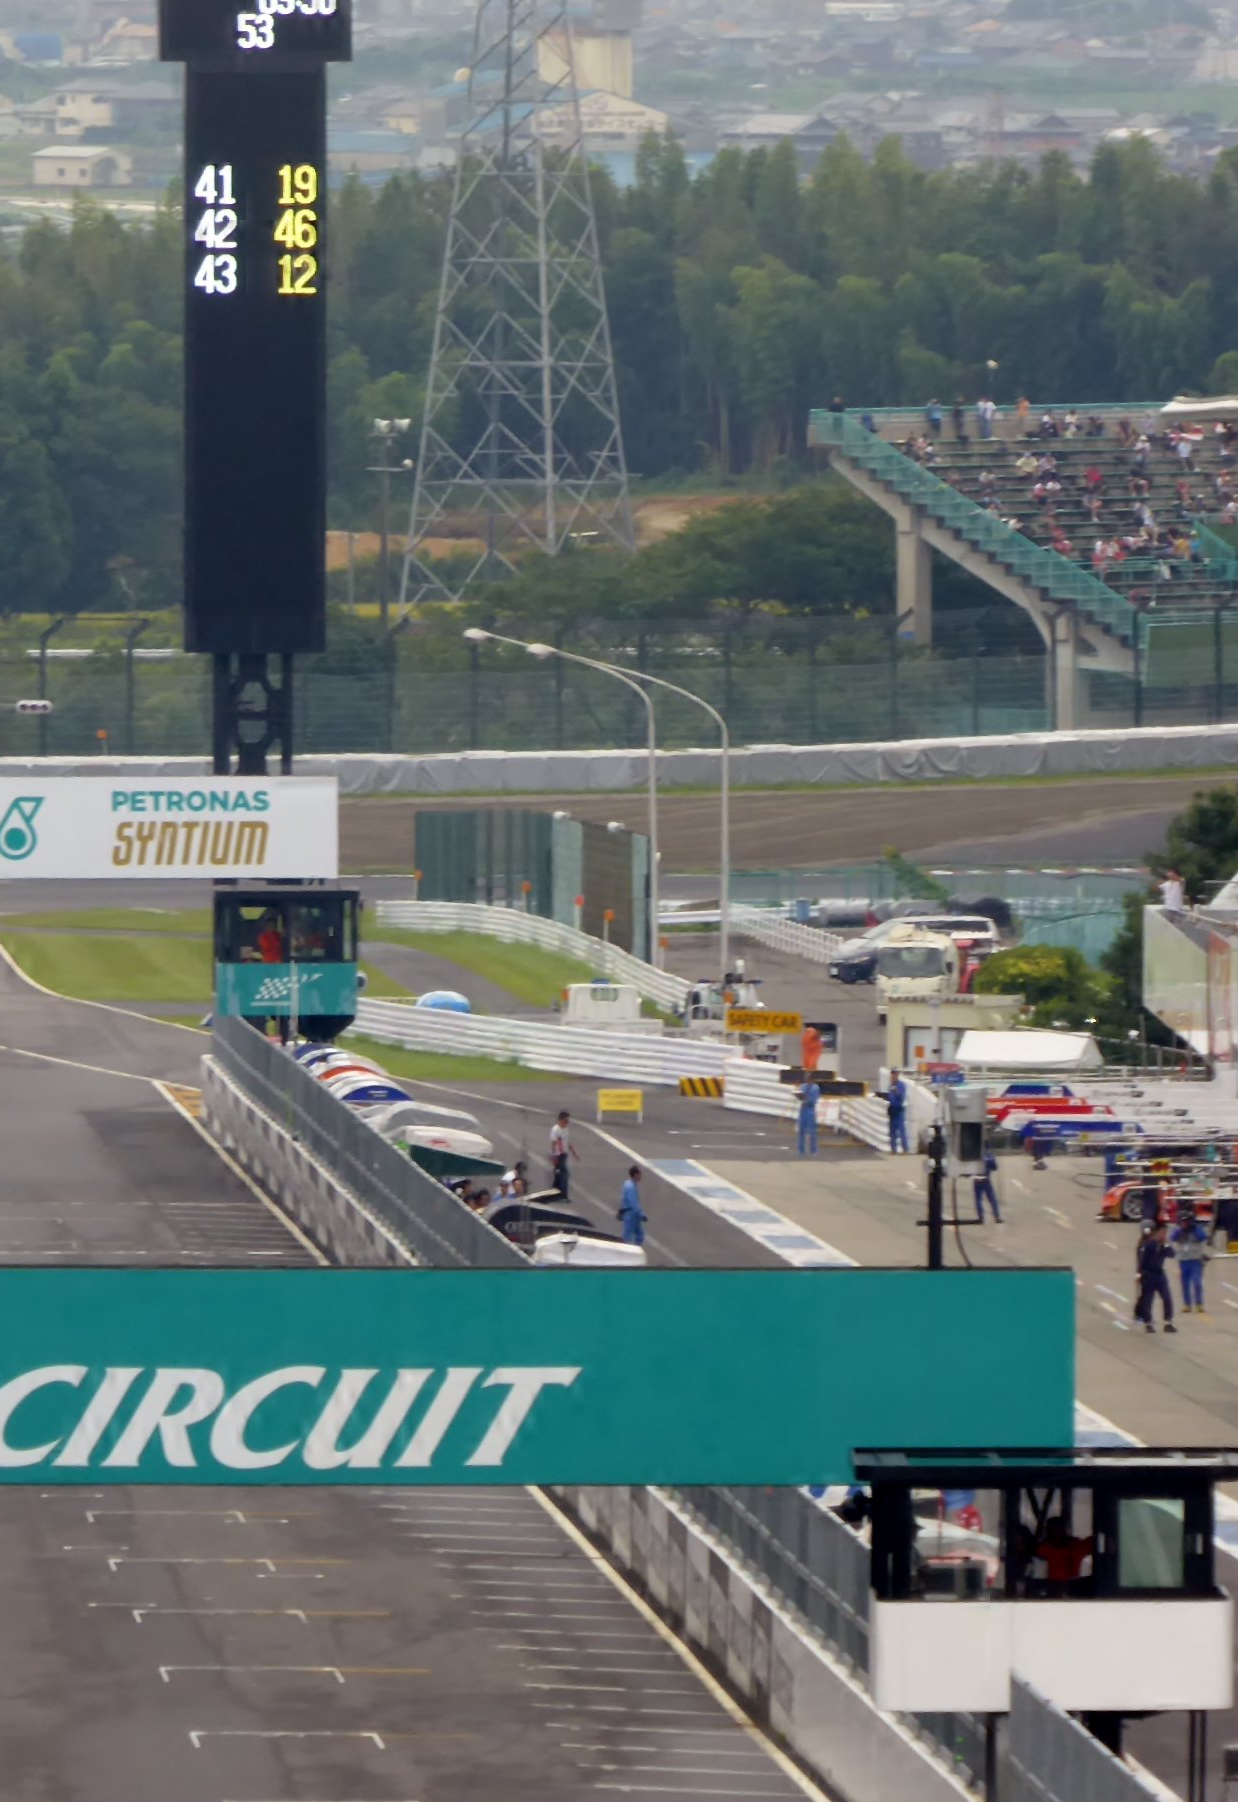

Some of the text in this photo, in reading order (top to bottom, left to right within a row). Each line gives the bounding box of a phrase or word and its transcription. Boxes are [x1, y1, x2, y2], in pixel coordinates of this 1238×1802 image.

[237, 13, 274, 49] 53
[194, 164, 317, 205] 41 19
[194, 208, 317, 249] 42 46
[194, 253, 317, 294] 43 12
[111, 790, 270, 812] PETRONAS
[111, 821, 269, 866] SYNTIUM
[729, 1011, 797, 1029] SAFETY CAR
